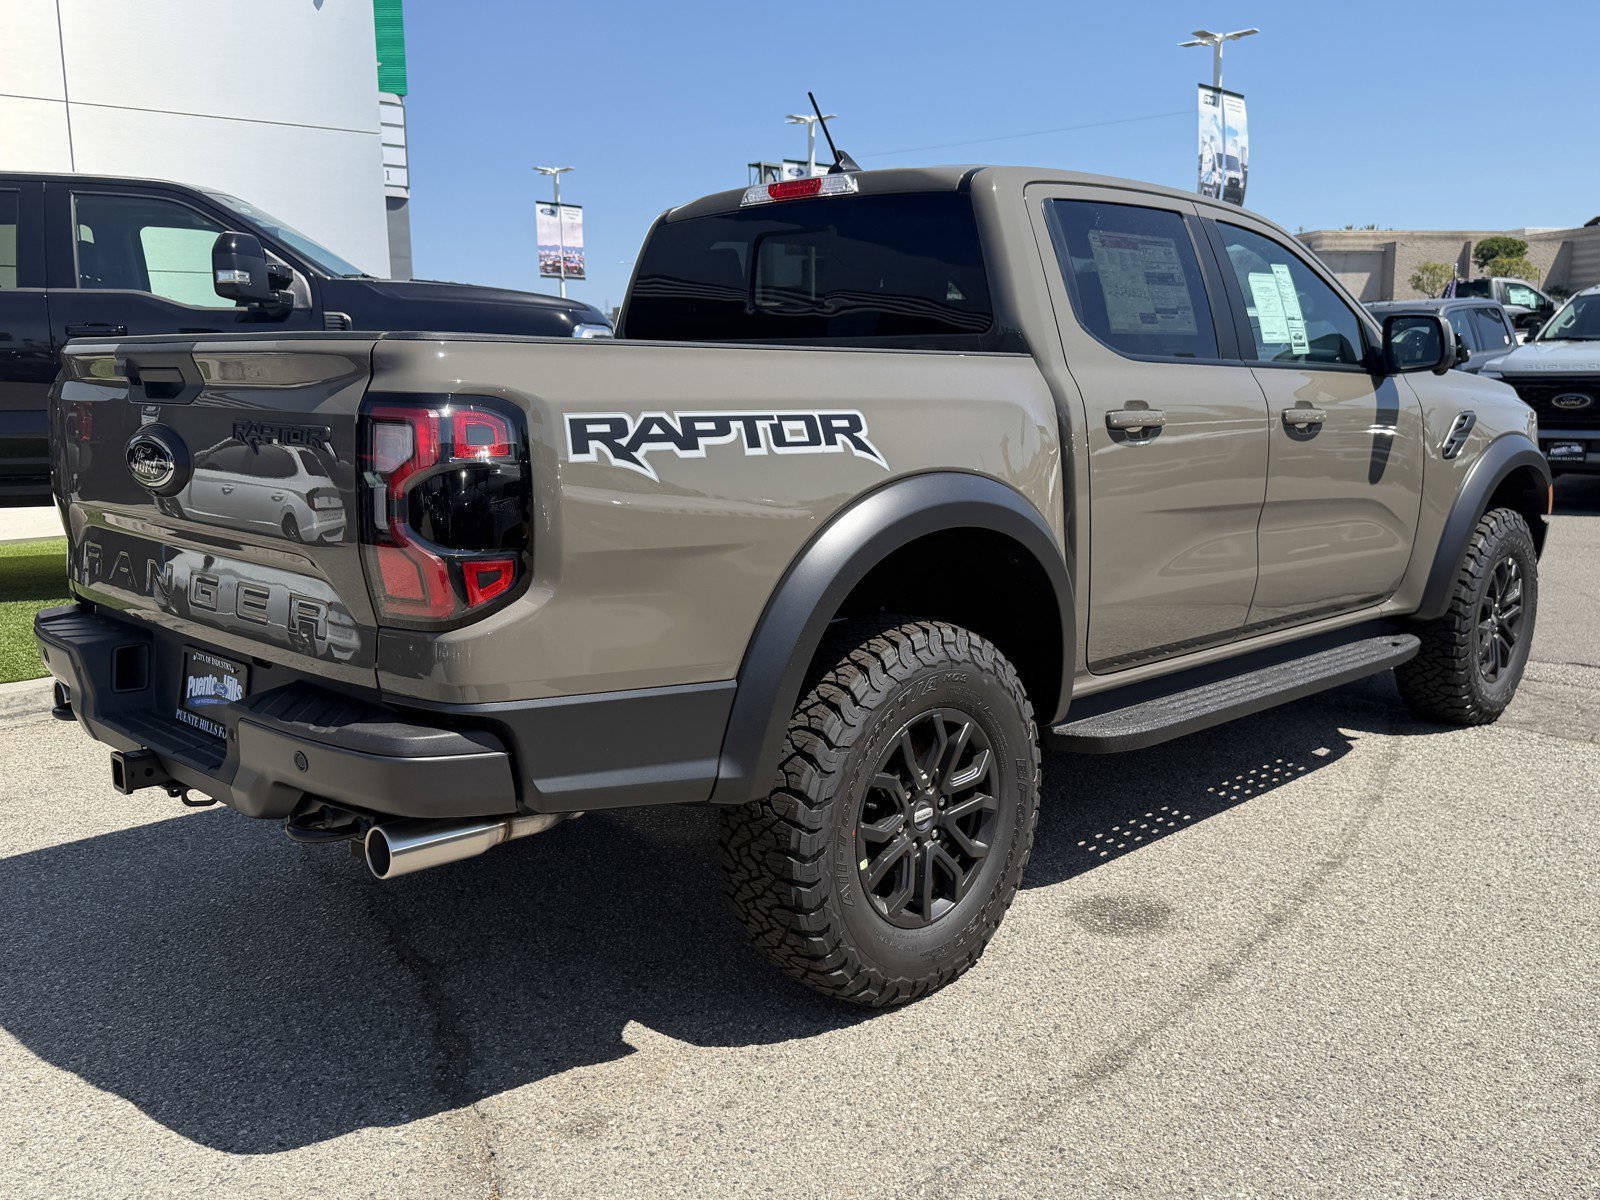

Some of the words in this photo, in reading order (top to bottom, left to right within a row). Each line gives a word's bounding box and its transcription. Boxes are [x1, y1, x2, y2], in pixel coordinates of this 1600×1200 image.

[232, 420, 339, 465] RAPTOR
[563, 409, 891, 483] RAPTOR
[131, 444, 159, 477] Ford
[83, 540, 329, 641] RANGER
[195, 652, 205, 662] CITY
[205, 655, 211, 664] OF
[211, 657, 232, 671] INDUSTRY
[187, 674, 217, 698] Puente
[222, 674, 243, 701] Hills
[176, 708, 199, 728] PUENTE
[199, 718, 218, 736] HILLS
[218, 724, 227, 739] FO
